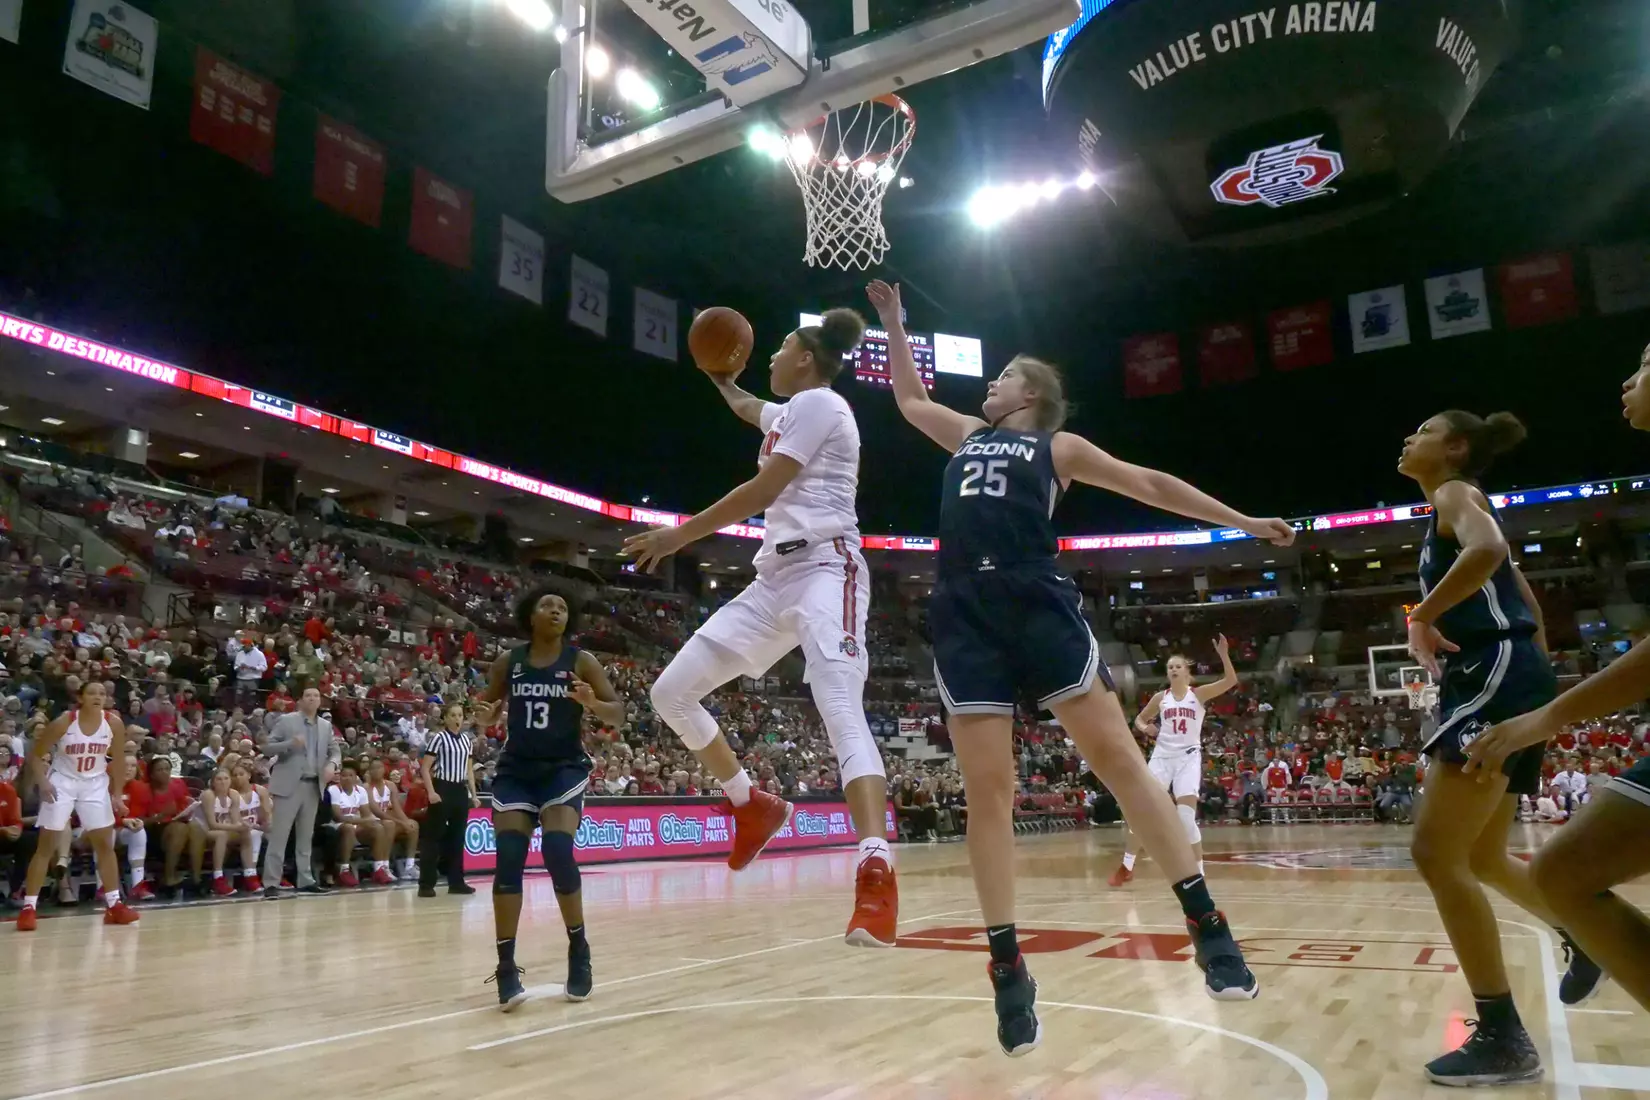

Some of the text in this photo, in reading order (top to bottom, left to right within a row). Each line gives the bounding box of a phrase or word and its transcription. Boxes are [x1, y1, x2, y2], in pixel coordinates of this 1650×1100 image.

[1128, 1, 1376, 90] VALUE CITY ARENA
[1436, 17, 1476, 75] VALUE
[512, 252, 534, 282] 35
[578, 288, 601, 317] 22
[645, 319, 668, 344] 21
[47, 331, 178, 384] DESTINATION
[953, 442, 1035, 462] UCONN
[500, 471, 540, 493] SPORTS
[960, 459, 1009, 497] 25
[1112, 535, 1155, 548] SPORTS
[512, 683, 568, 698] UCONN
[525, 701, 550, 729] 13
[1172, 718, 1188, 734] 14
[77, 756, 97, 773] 10
[628, 818, 651, 832] AUTO
[706, 816, 726, 829] AUTO
[796, 812, 828, 835] O'Reilly
[829, 823, 847, 834] PARTS
[830, 812, 845, 823] AUTO
[574, 817, 625, 848] O'Reilly
[626, 832, 654, 846] PARTS
[660, 815, 703, 844] O'Reilly
[704, 829, 729, 842] PARTS
